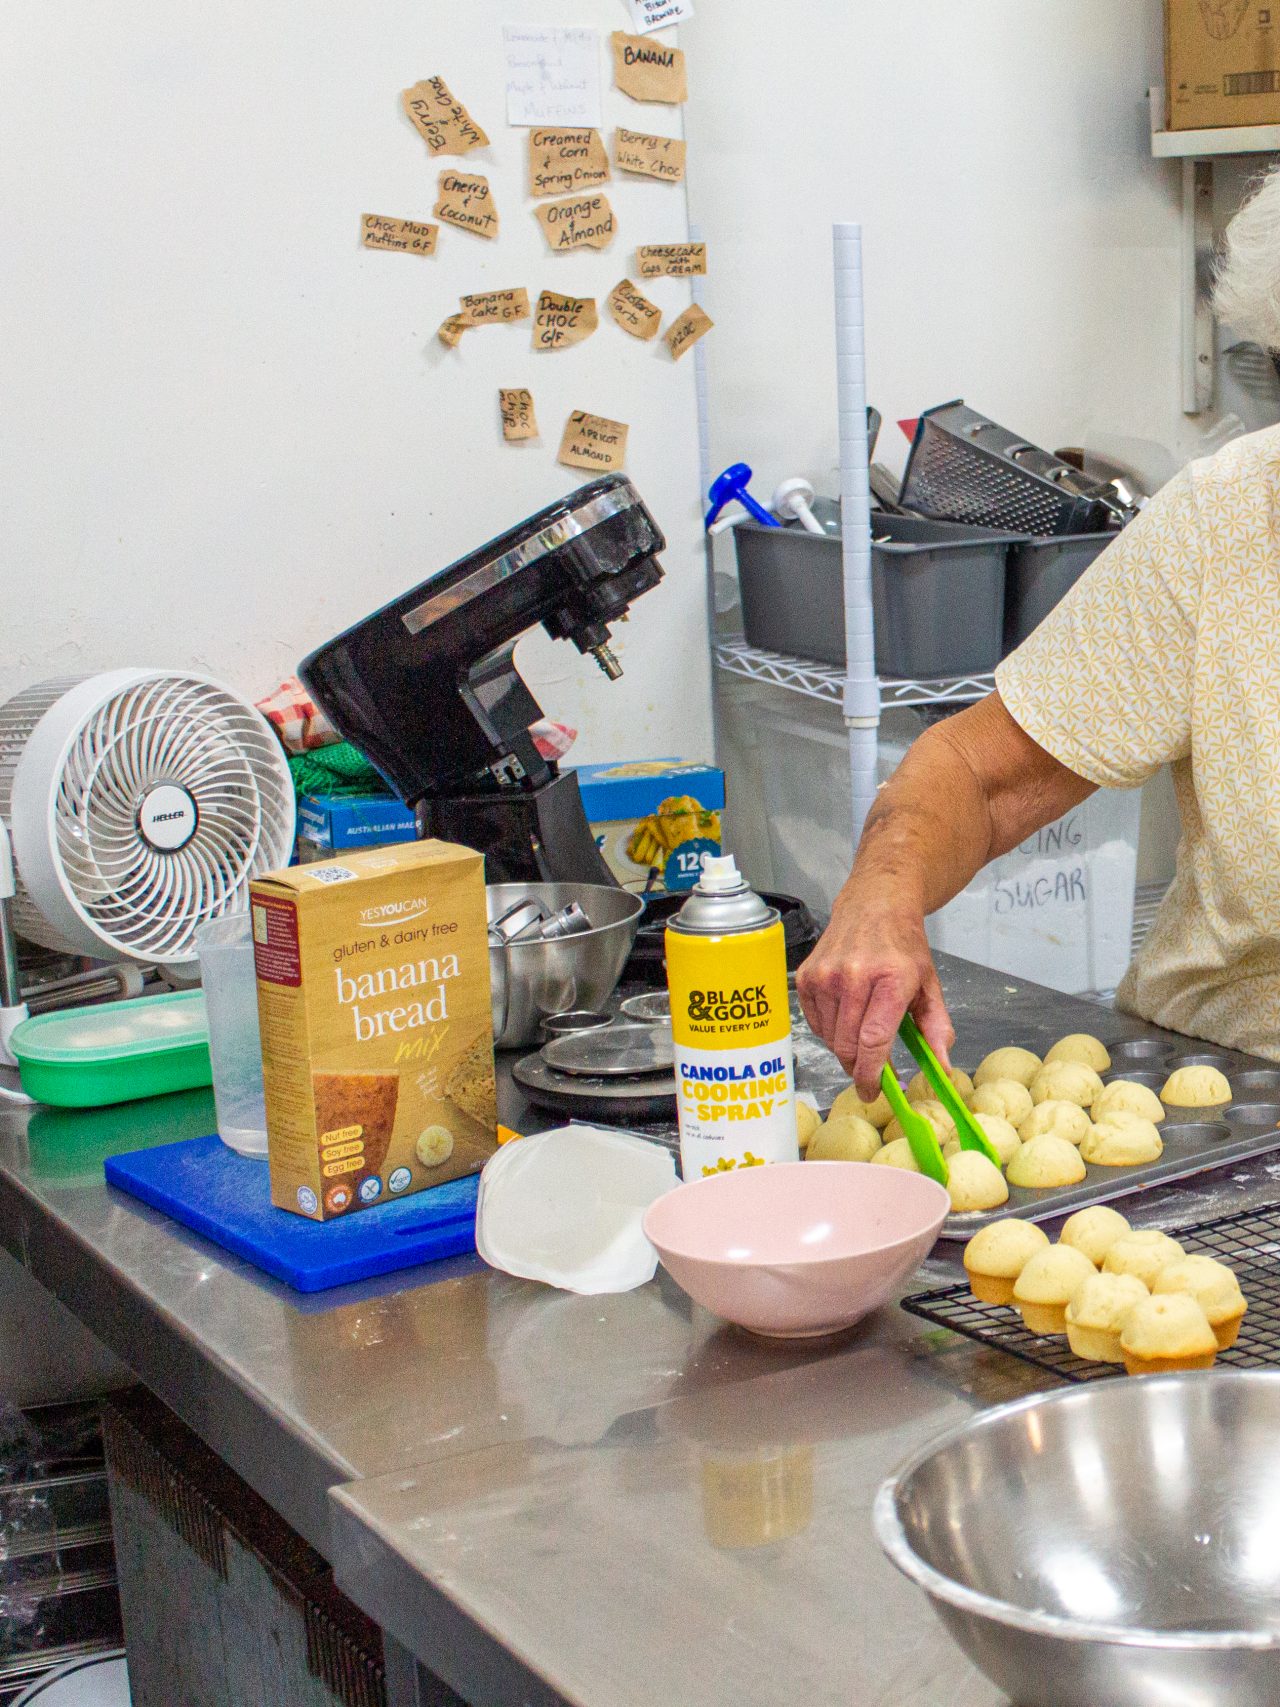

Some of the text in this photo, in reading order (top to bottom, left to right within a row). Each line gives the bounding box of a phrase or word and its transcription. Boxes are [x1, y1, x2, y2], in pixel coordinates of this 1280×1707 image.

[624, 46, 675, 68] BANANA
[427, 75, 453, 106] Choc
[410, 99, 447, 151] Berry
[533, 131, 592, 147] Creamed
[618, 129, 659, 151] Berry
[574, 167, 607, 181] Onion
[616, 151, 681, 177] White Choc
[442, 176, 490, 200] Cherry
[440, 203, 497, 228] Coconut
[547, 198, 602, 223] Orange
[365, 216, 396, 233] Choc
[558, 212, 614, 247] Almond
[640, 245, 703, 259] Cheesecake
[539, 297, 583, 312] Double
[537, 314, 578, 328] CHOC
[540, 329, 564, 348] G/F
[579, 427, 620, 446] APRICOT
[569, 444, 613, 464] ALMOND
[152, 810, 185, 823] HELLER
[346, 821, 396, 836] AUSTRALIAN
[993, 866, 1087, 914] SUGAR
[360, 897, 428, 921] YESYOUCAN
[332, 921, 459, 963] gluten & dairy free
[334, 952, 462, 1005] banana
[706, 984, 767, 1005] BLACK
[351, 983, 449, 1042] bread
[714, 1000, 770, 1021] GOLD
[689, 1018, 770, 1033] VALUE EVERY DAY
[393, 1025, 450, 1064] mix
[680, 1056, 786, 1081] CANOLA OIL
[682, 1072, 788, 1103] COOKING
[325, 1128, 360, 1142] Nut free
[326, 1144, 360, 1160] Soy free
[327, 1159, 363, 1175] Egg free
